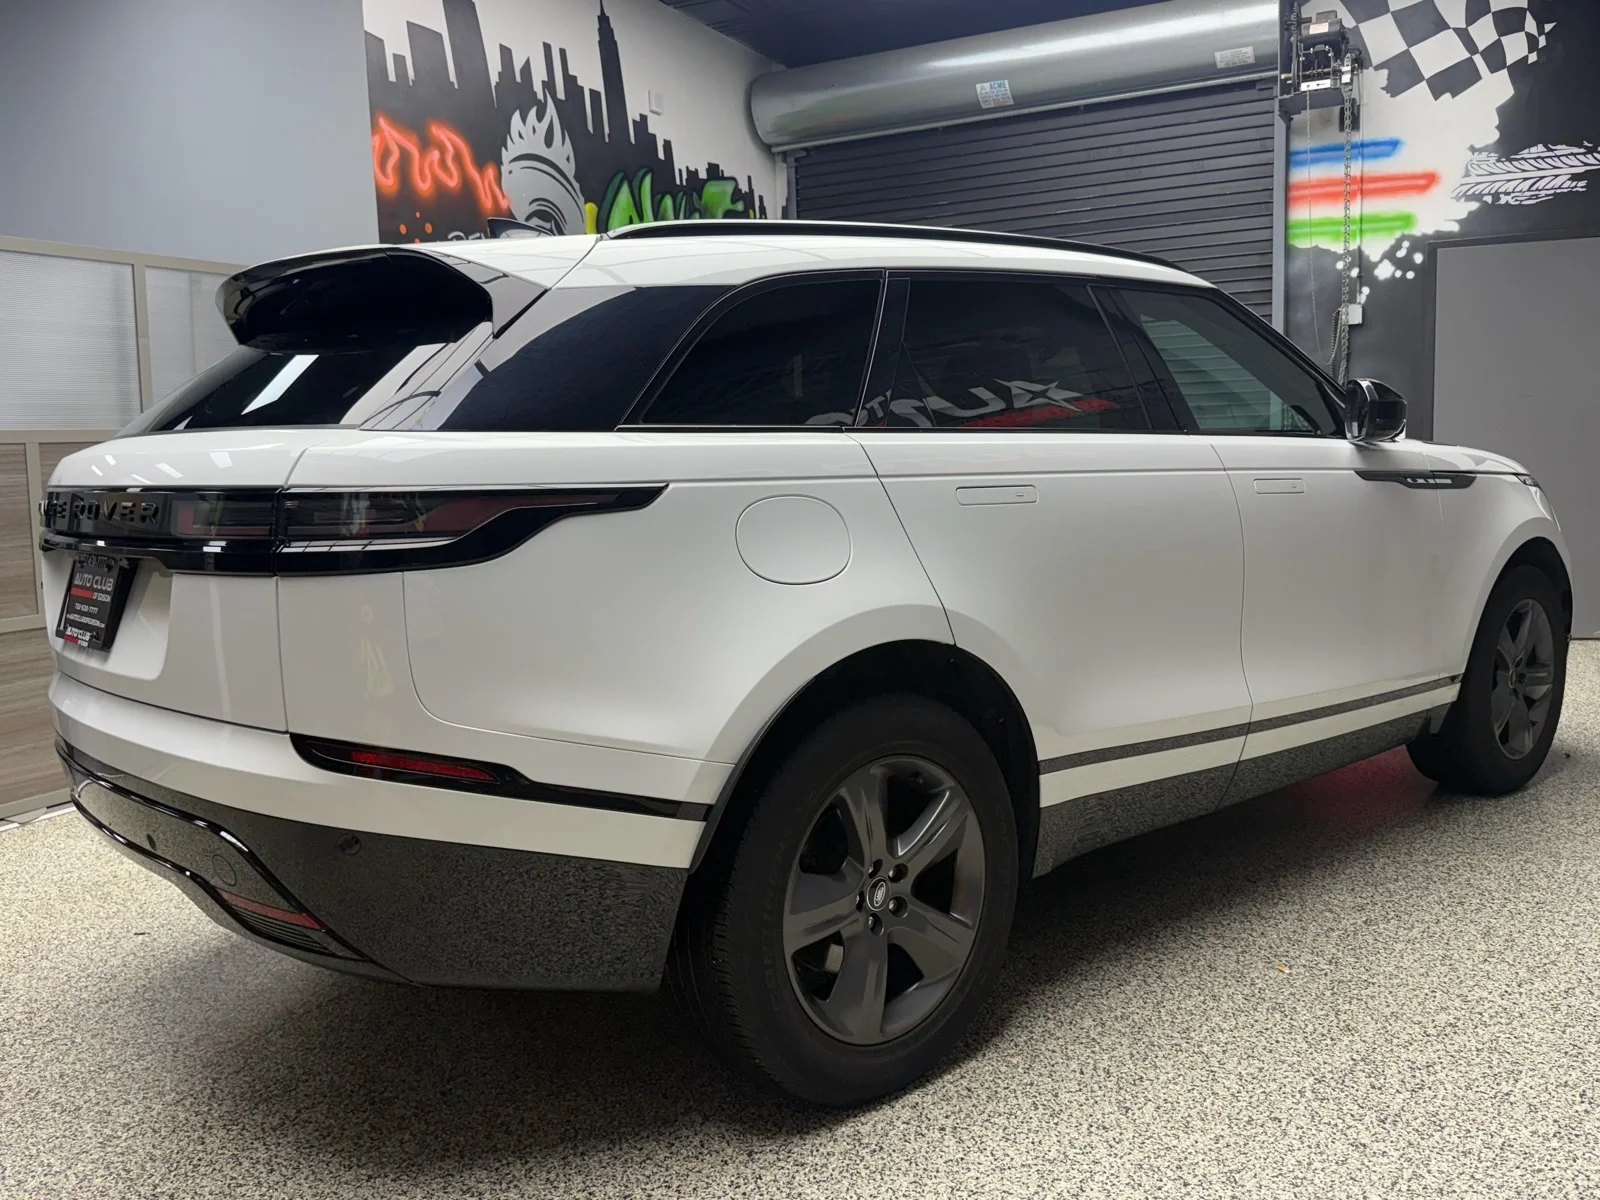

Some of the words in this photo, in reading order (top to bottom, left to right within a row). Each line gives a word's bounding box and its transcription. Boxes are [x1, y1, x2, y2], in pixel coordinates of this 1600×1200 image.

[989, 80, 1007, 90] ACME
[72, 500, 159, 524] ROVER
[74, 573, 92, 587] AUTO
[93, 576, 114, 591] CLUB
